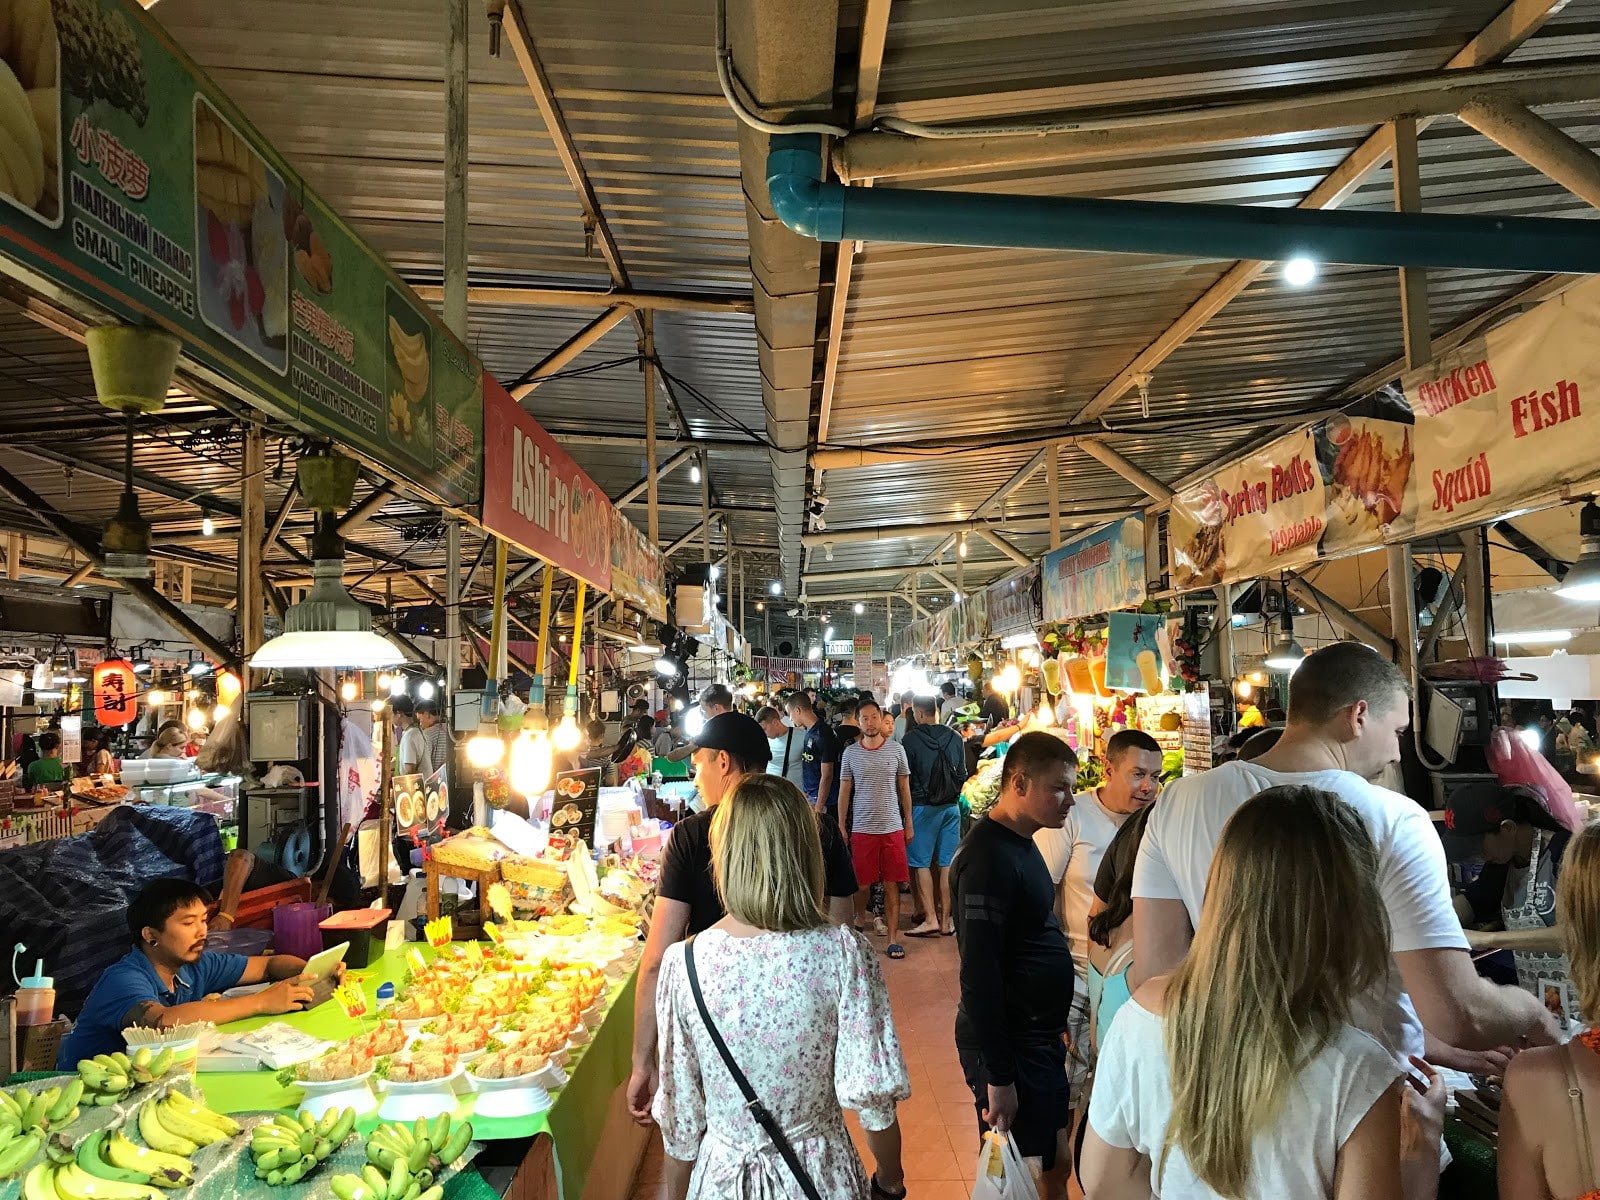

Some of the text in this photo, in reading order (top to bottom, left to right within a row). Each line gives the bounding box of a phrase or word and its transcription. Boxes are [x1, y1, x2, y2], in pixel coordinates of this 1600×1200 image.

[69, 113, 150, 199] 小菠萝
[73, 218, 194, 318] SMALL PINEAPPLE
[292, 366, 320, 401] MANGO
[321, 384, 340, 413] WITH
[340, 396, 361, 426] STICKY
[361, 410, 377, 435] RICE
[1510, 379, 1581, 438] Fish
[1220, 454, 1315, 527] Spring Rolls
[1431, 452, 1491, 513] Squid
